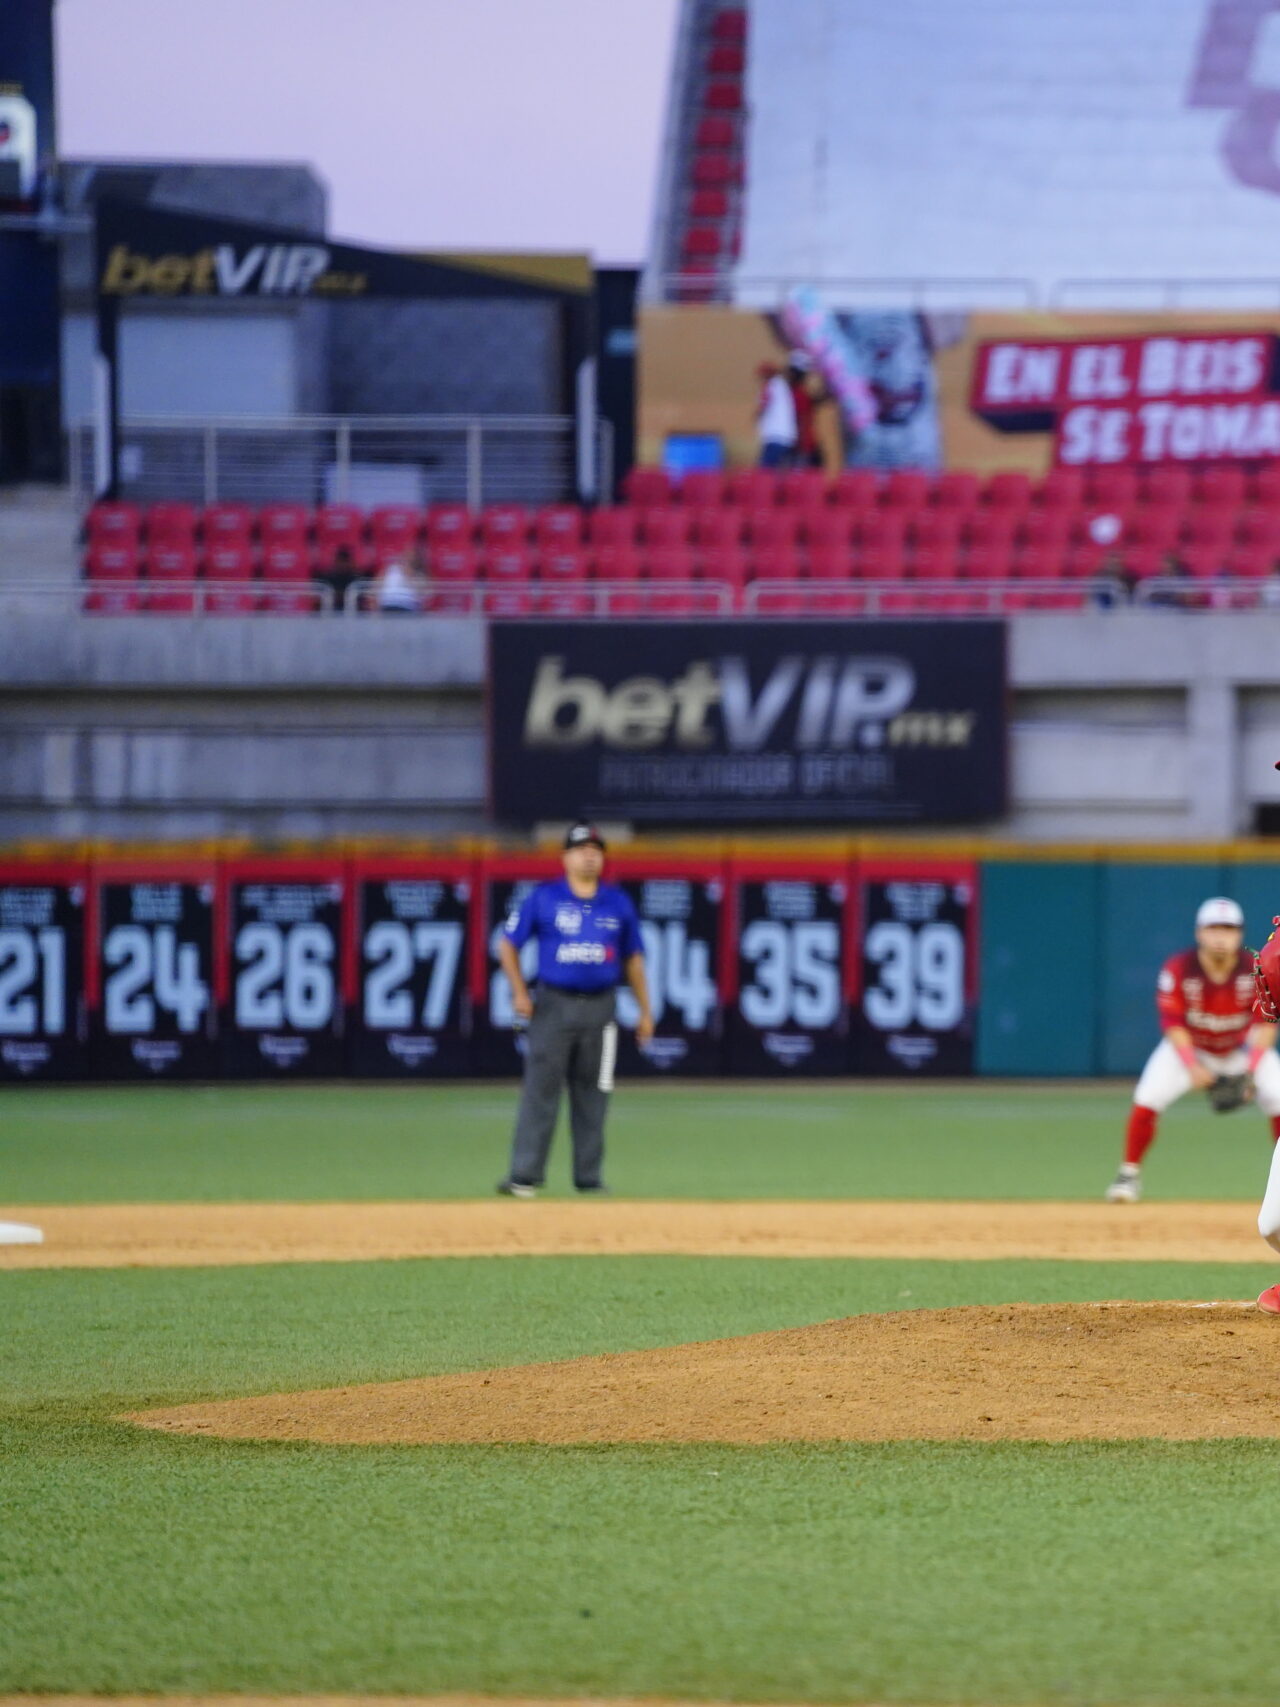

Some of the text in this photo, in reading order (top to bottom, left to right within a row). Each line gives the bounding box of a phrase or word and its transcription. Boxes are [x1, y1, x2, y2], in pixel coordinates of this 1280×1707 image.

[984, 335, 1264, 402] EN EL BEIS
[1062, 408, 1128, 463] SE
[0, 925, 66, 1035] 21
[104, 924, 209, 1034] 24
[235, 922, 334, 1030] 26
[363, 922, 463, 1031] 27
[741, 921, 840, 1029] 35
[865, 922, 966, 1031] 39
